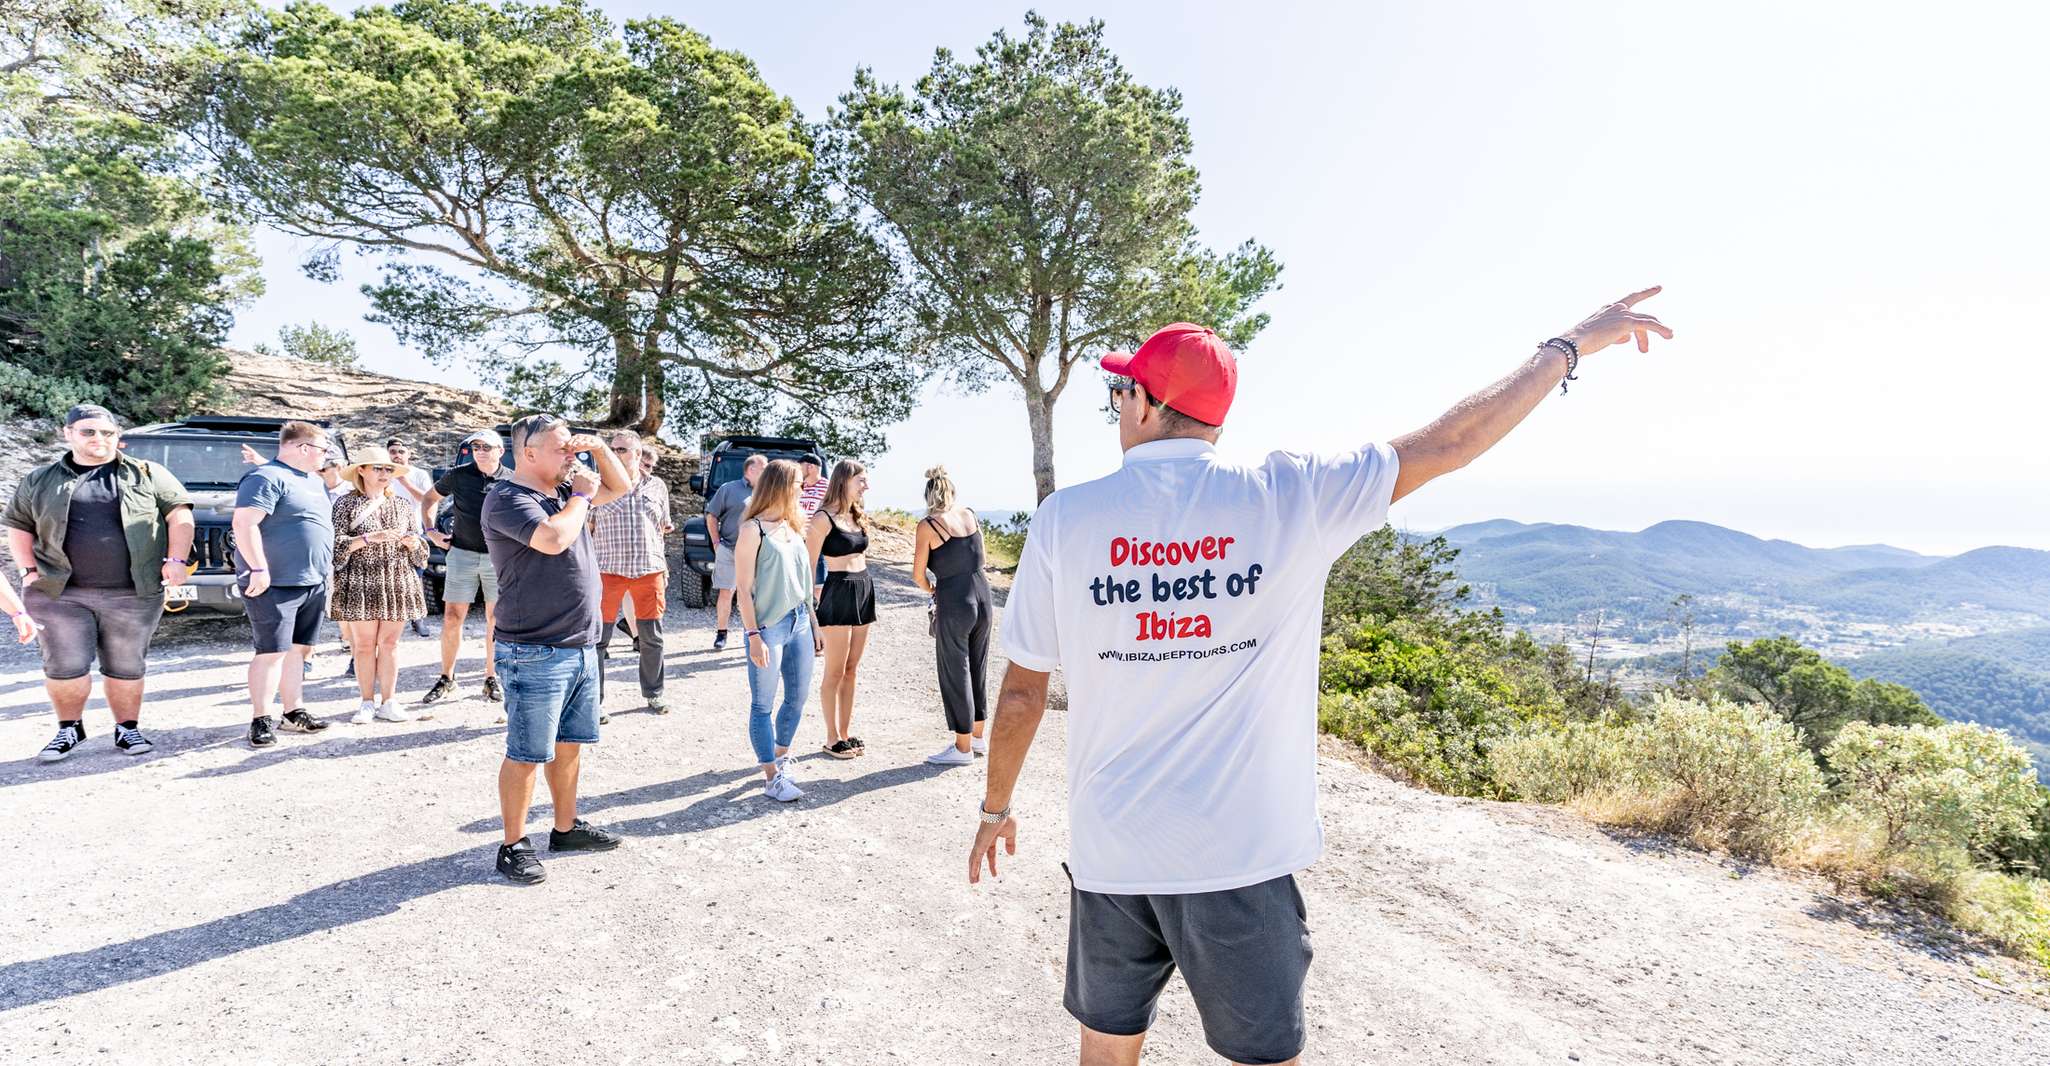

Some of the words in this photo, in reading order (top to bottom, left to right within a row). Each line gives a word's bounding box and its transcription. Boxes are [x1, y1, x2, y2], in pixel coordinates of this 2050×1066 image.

[1110, 536, 1235, 567] Discover
[1089, 574, 1142, 606] the
[1152, 569, 1217, 603] best
[1226, 563, 1263, 597] of
[1136, 611, 1212, 641] Ibiza
